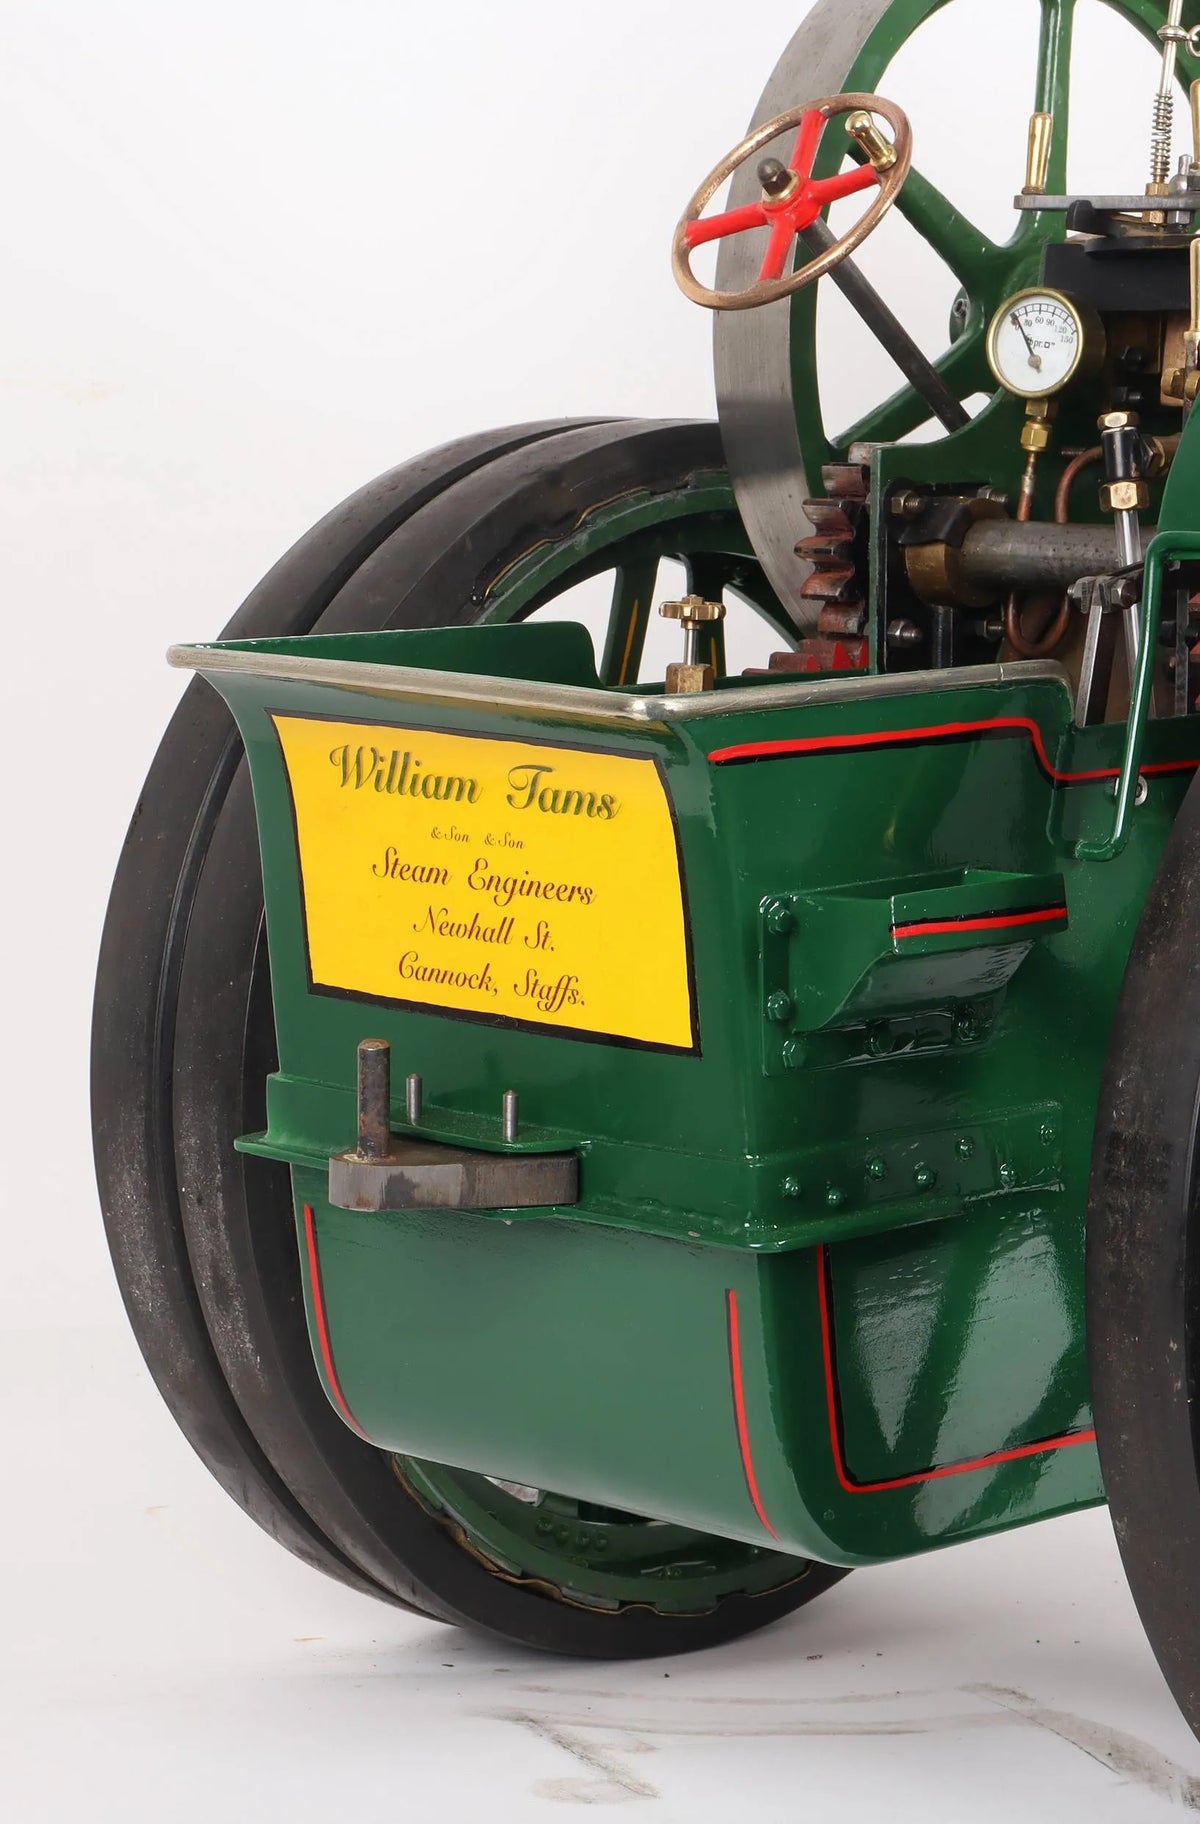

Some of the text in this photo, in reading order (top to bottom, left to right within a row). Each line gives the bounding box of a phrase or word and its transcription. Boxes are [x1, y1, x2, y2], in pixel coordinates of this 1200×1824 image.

[1035, 316, 1043, 324] 60
[1046, 318, 1055, 327] 90
[1055, 325, 1067, 334] 120
[329, 744, 622, 820] William Tams
[372, 847, 596, 906] Steam Engineers
[413, 906, 555, 951] Newhall St.
[398, 951, 585, 1013] Cannock, Staffs.
